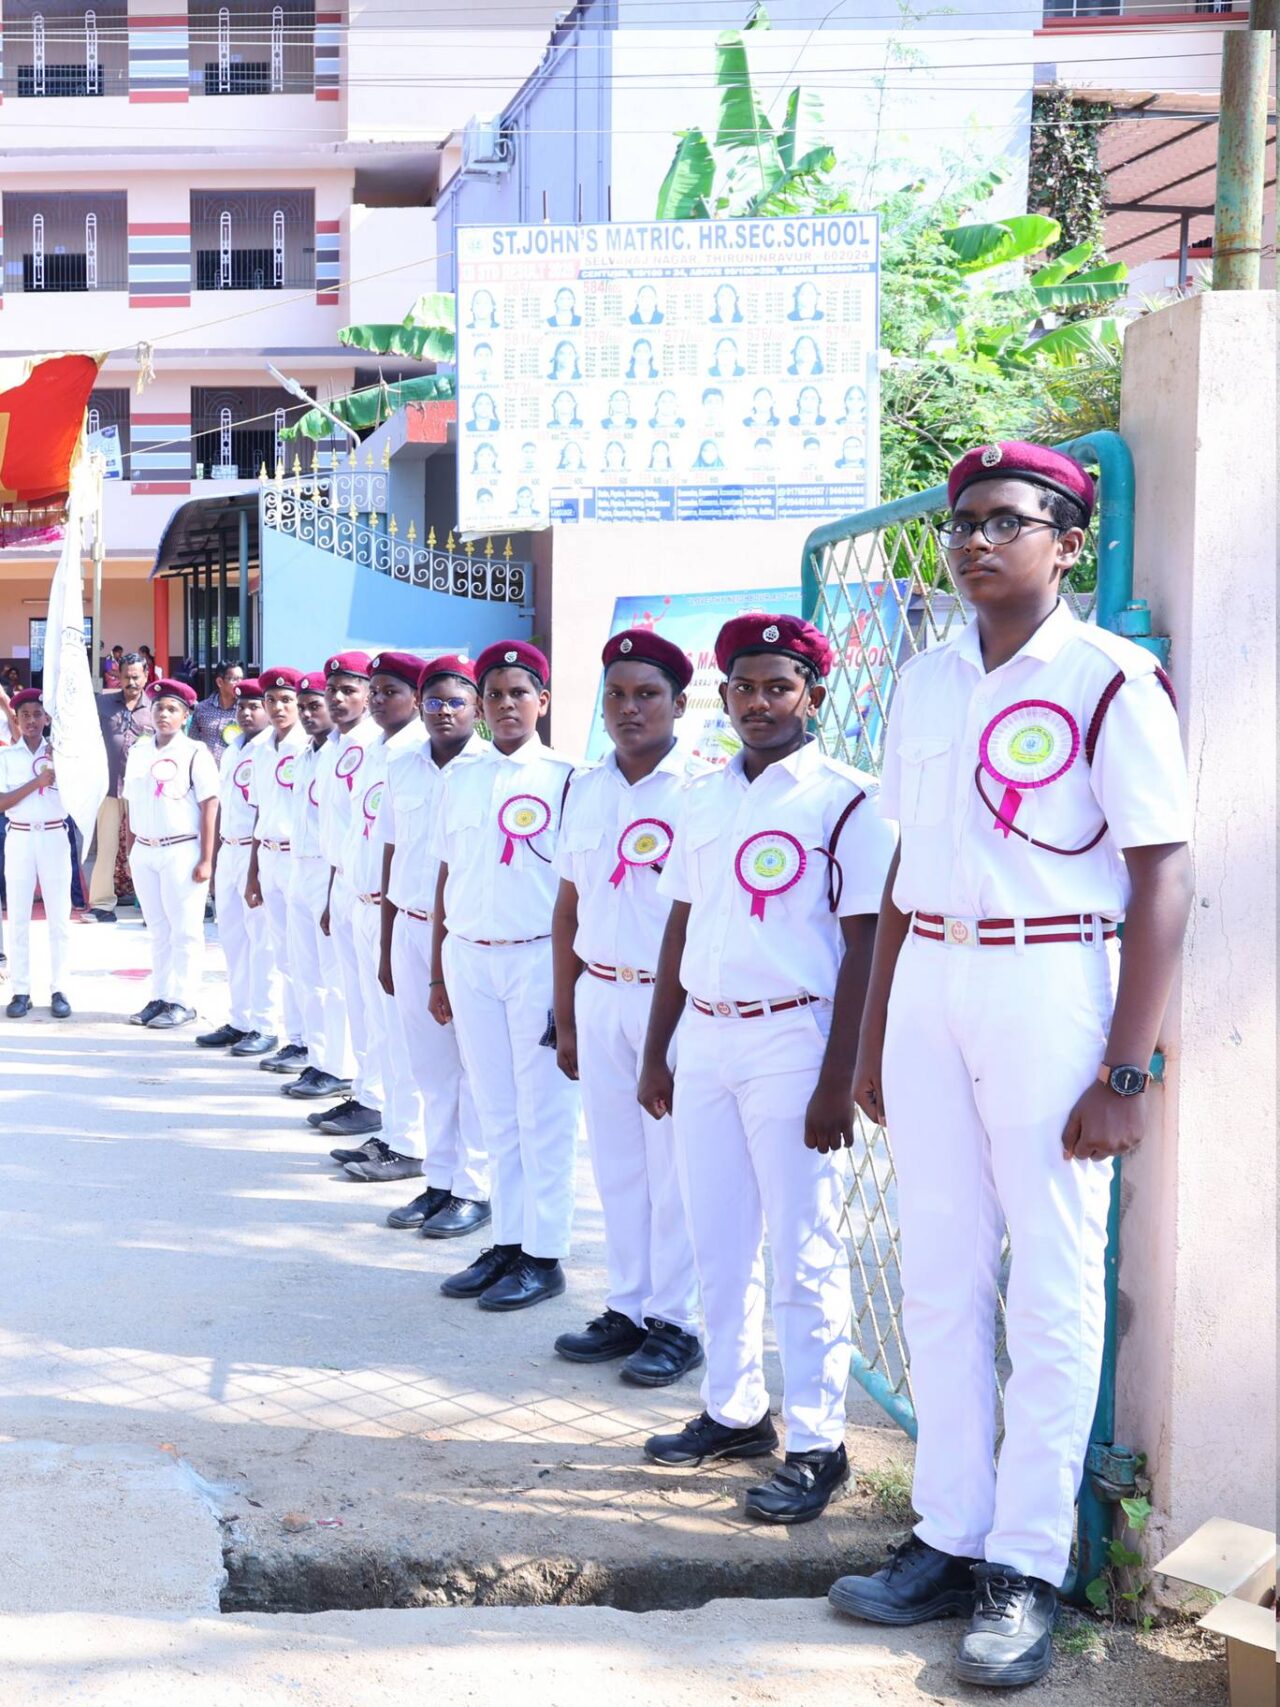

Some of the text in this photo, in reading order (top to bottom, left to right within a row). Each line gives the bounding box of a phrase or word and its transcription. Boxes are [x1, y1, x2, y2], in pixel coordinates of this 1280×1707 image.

[492, 220, 870, 256] ST.JOHN'S MATRIC. HR.SEC.SCHOOL
